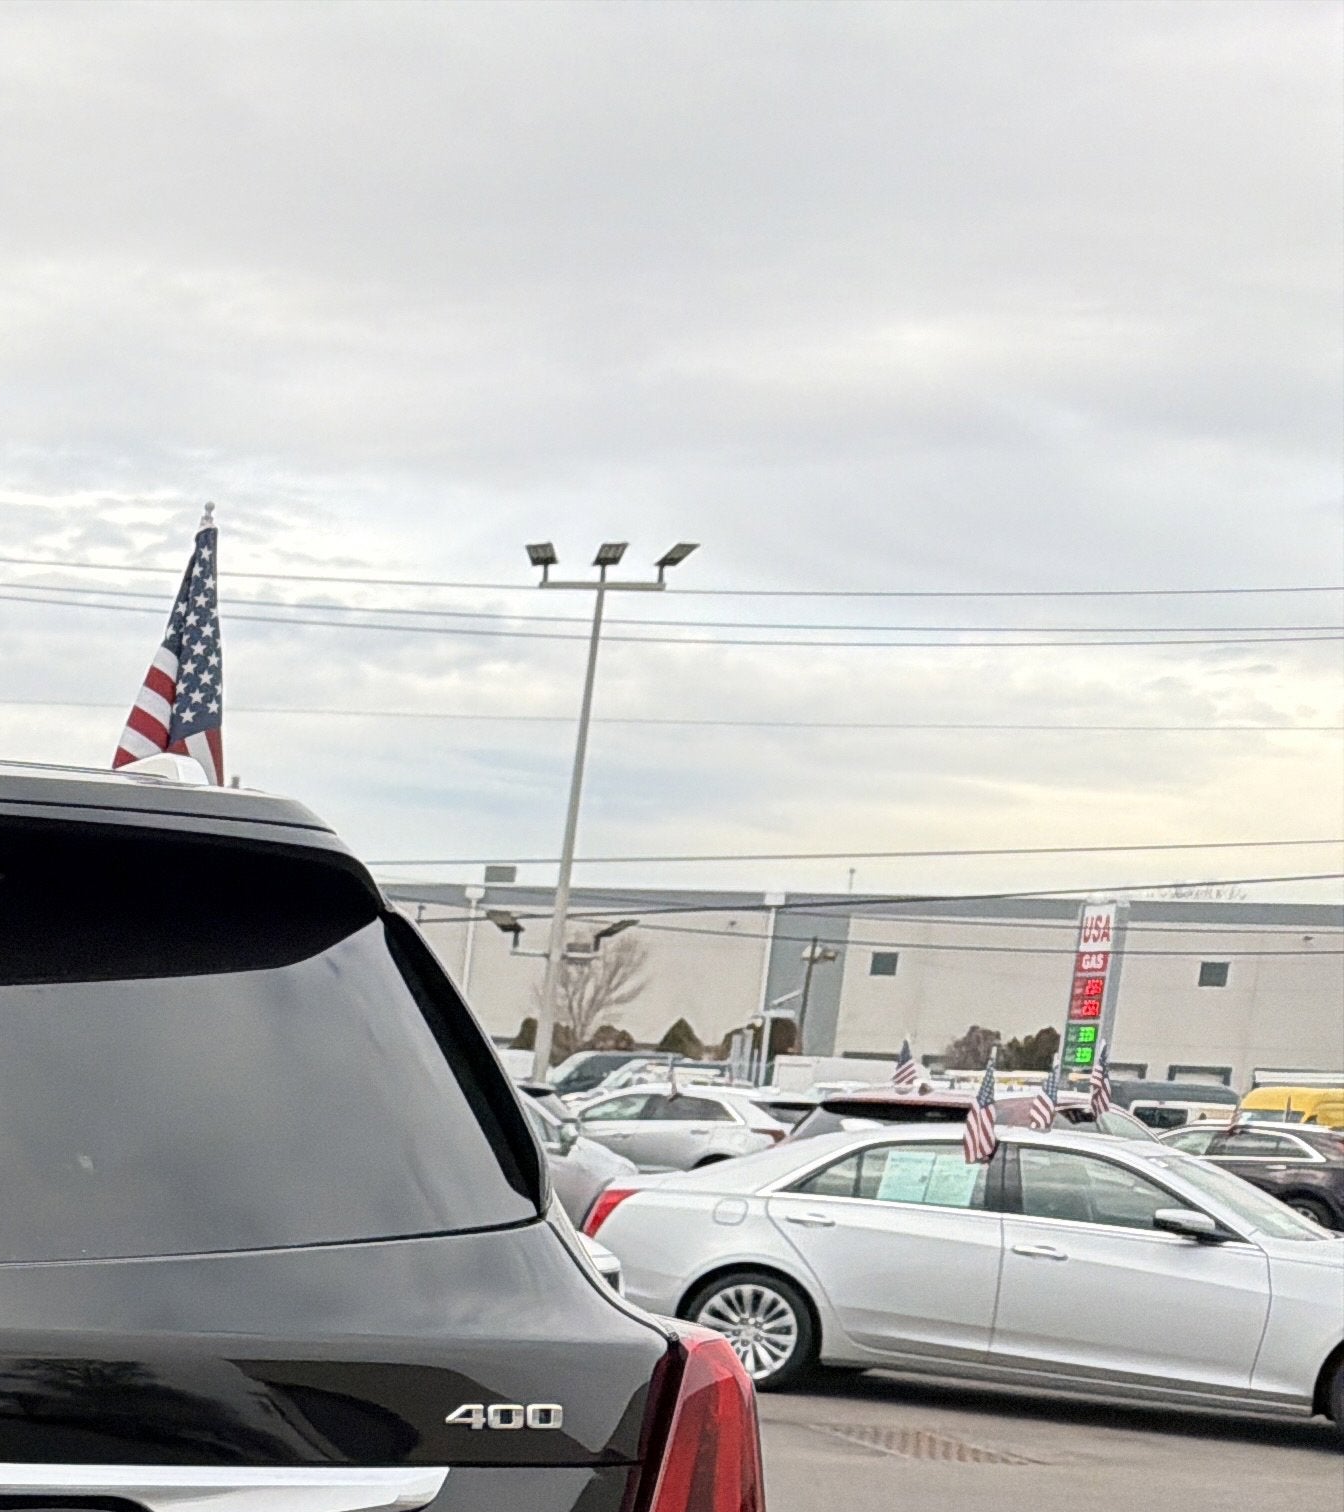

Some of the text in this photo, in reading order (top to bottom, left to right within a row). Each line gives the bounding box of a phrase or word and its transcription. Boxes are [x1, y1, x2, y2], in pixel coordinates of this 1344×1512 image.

[1083, 914, 1111, 943] USA
[1082, 953, 1104, 970] GAS
[445, 1403, 563, 1430] 400
